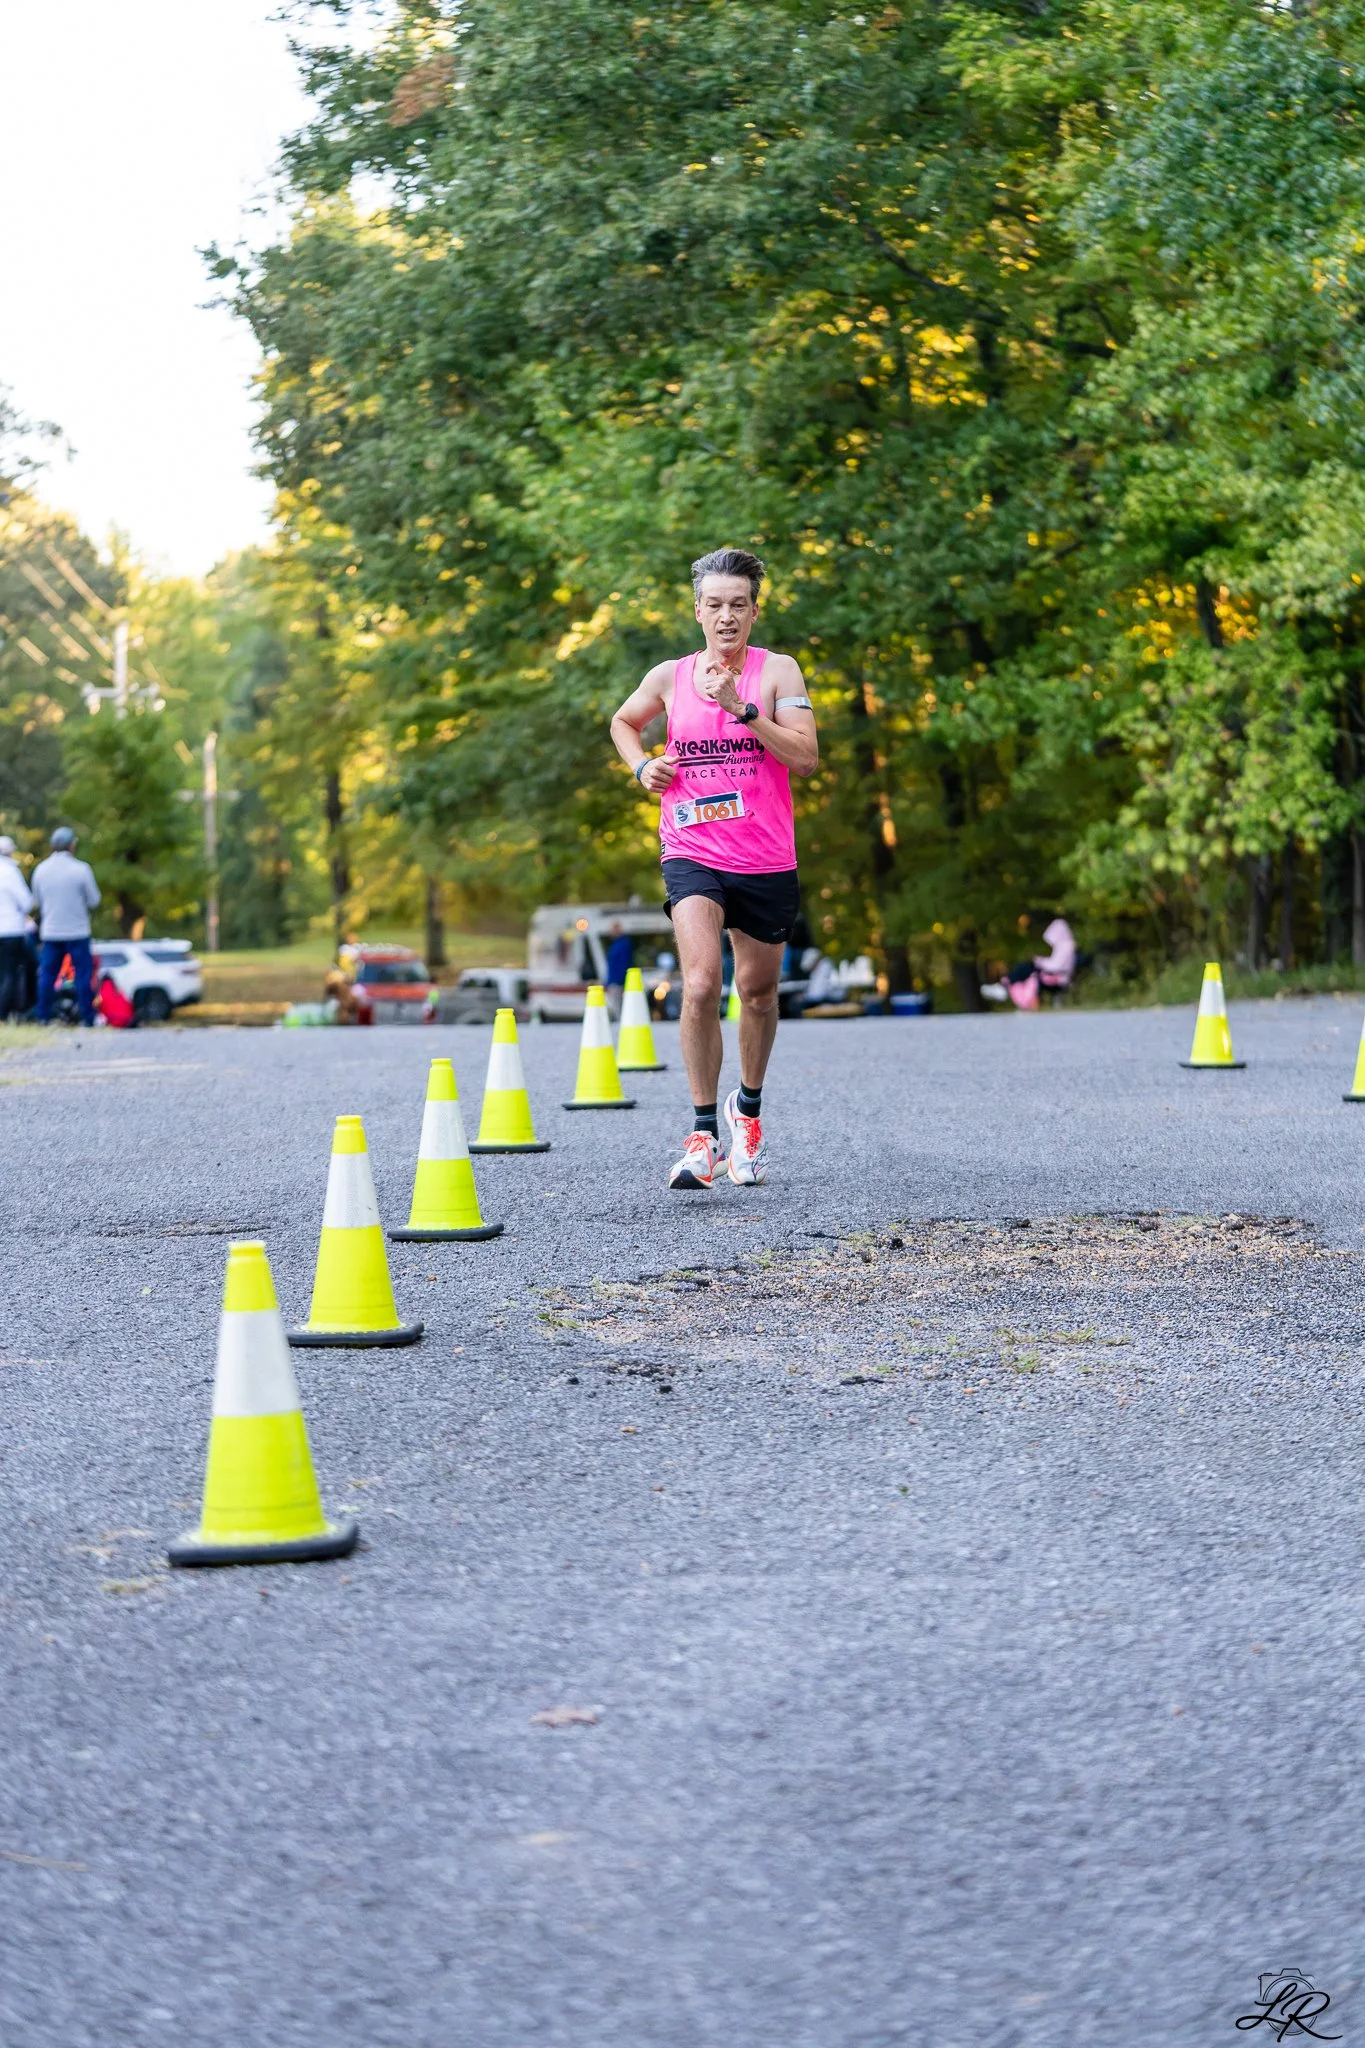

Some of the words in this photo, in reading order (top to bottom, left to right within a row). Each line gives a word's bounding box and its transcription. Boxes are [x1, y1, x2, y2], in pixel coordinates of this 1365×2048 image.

[724, 754, 766, 765] Running
[685, 768, 716, 779] RACE
[723, 767, 758, 777] TEAM
[694, 800, 739, 823] 1061
